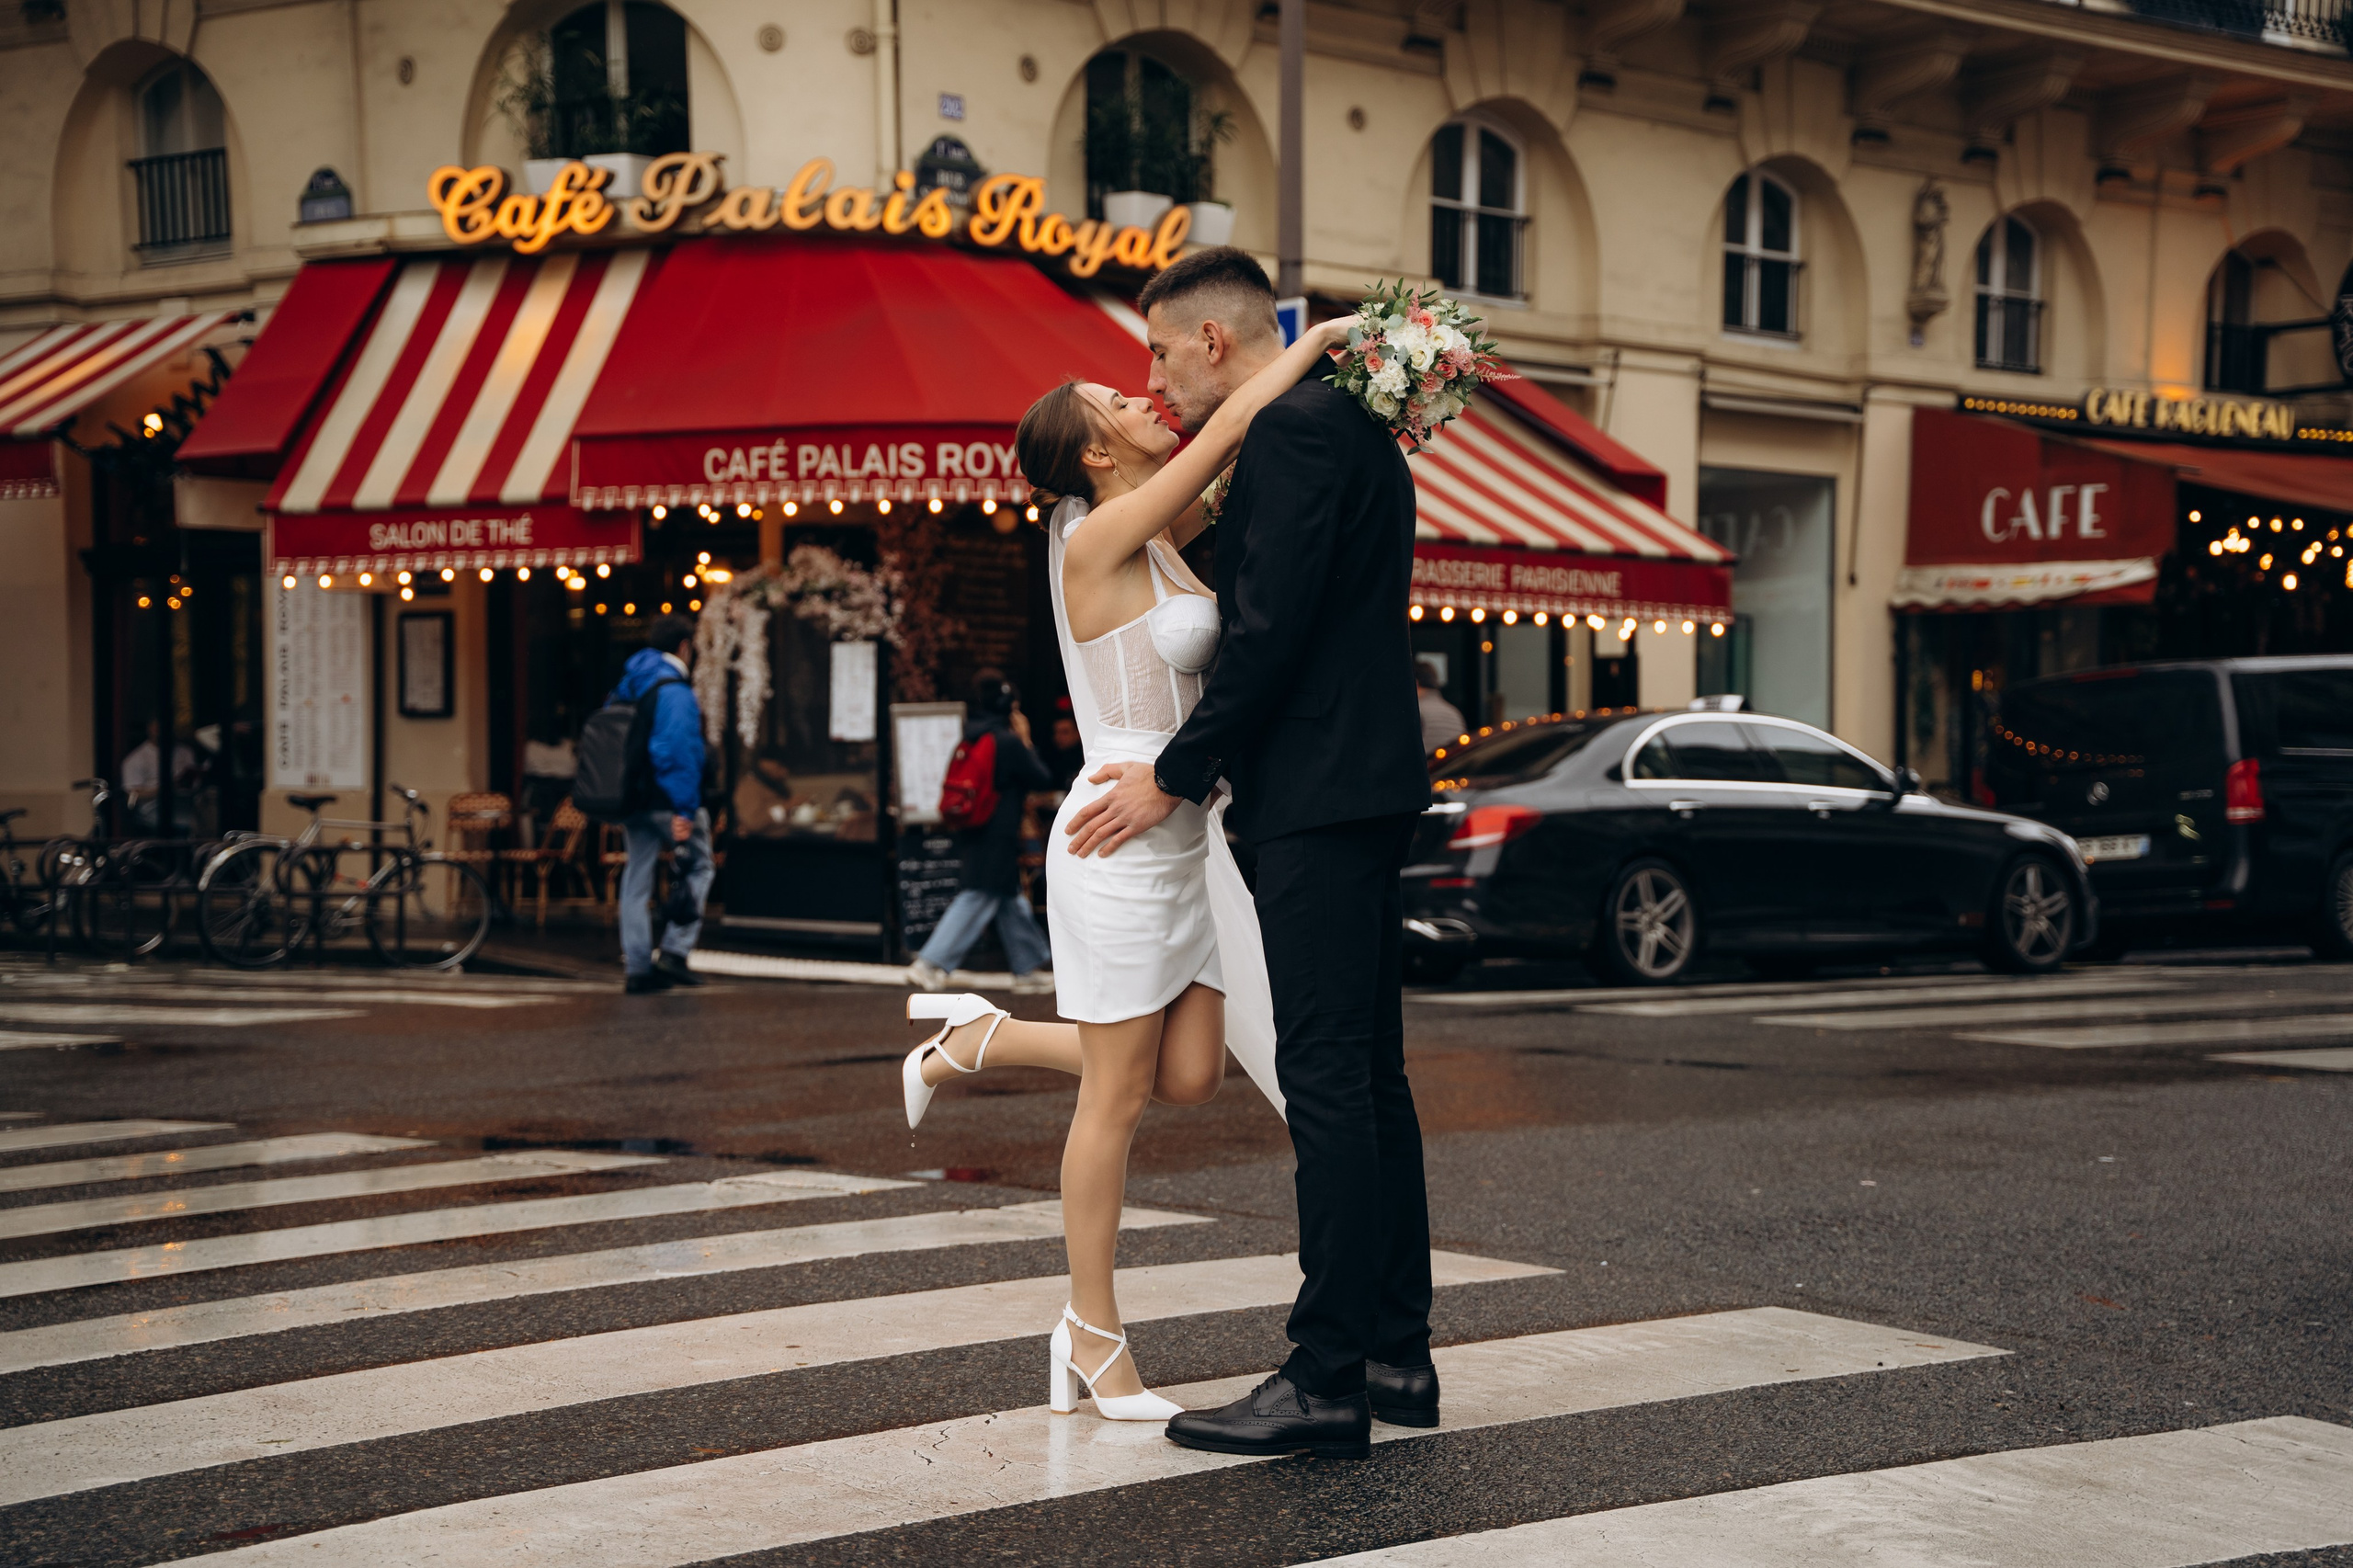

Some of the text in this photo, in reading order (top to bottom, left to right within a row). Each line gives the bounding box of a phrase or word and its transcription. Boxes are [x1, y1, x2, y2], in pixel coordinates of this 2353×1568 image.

[426, 151, 1193, 278] Café Palais Royal
[703, 437, 789, 483] CAFÉ
[797, 443, 926, 479] PALAIS
[369, 511, 533, 551] SALON DE THÉ
[1980, 483, 2109, 543] CAFE
[1411, 557, 1623, 597] RASSERIE PARISIENNE
